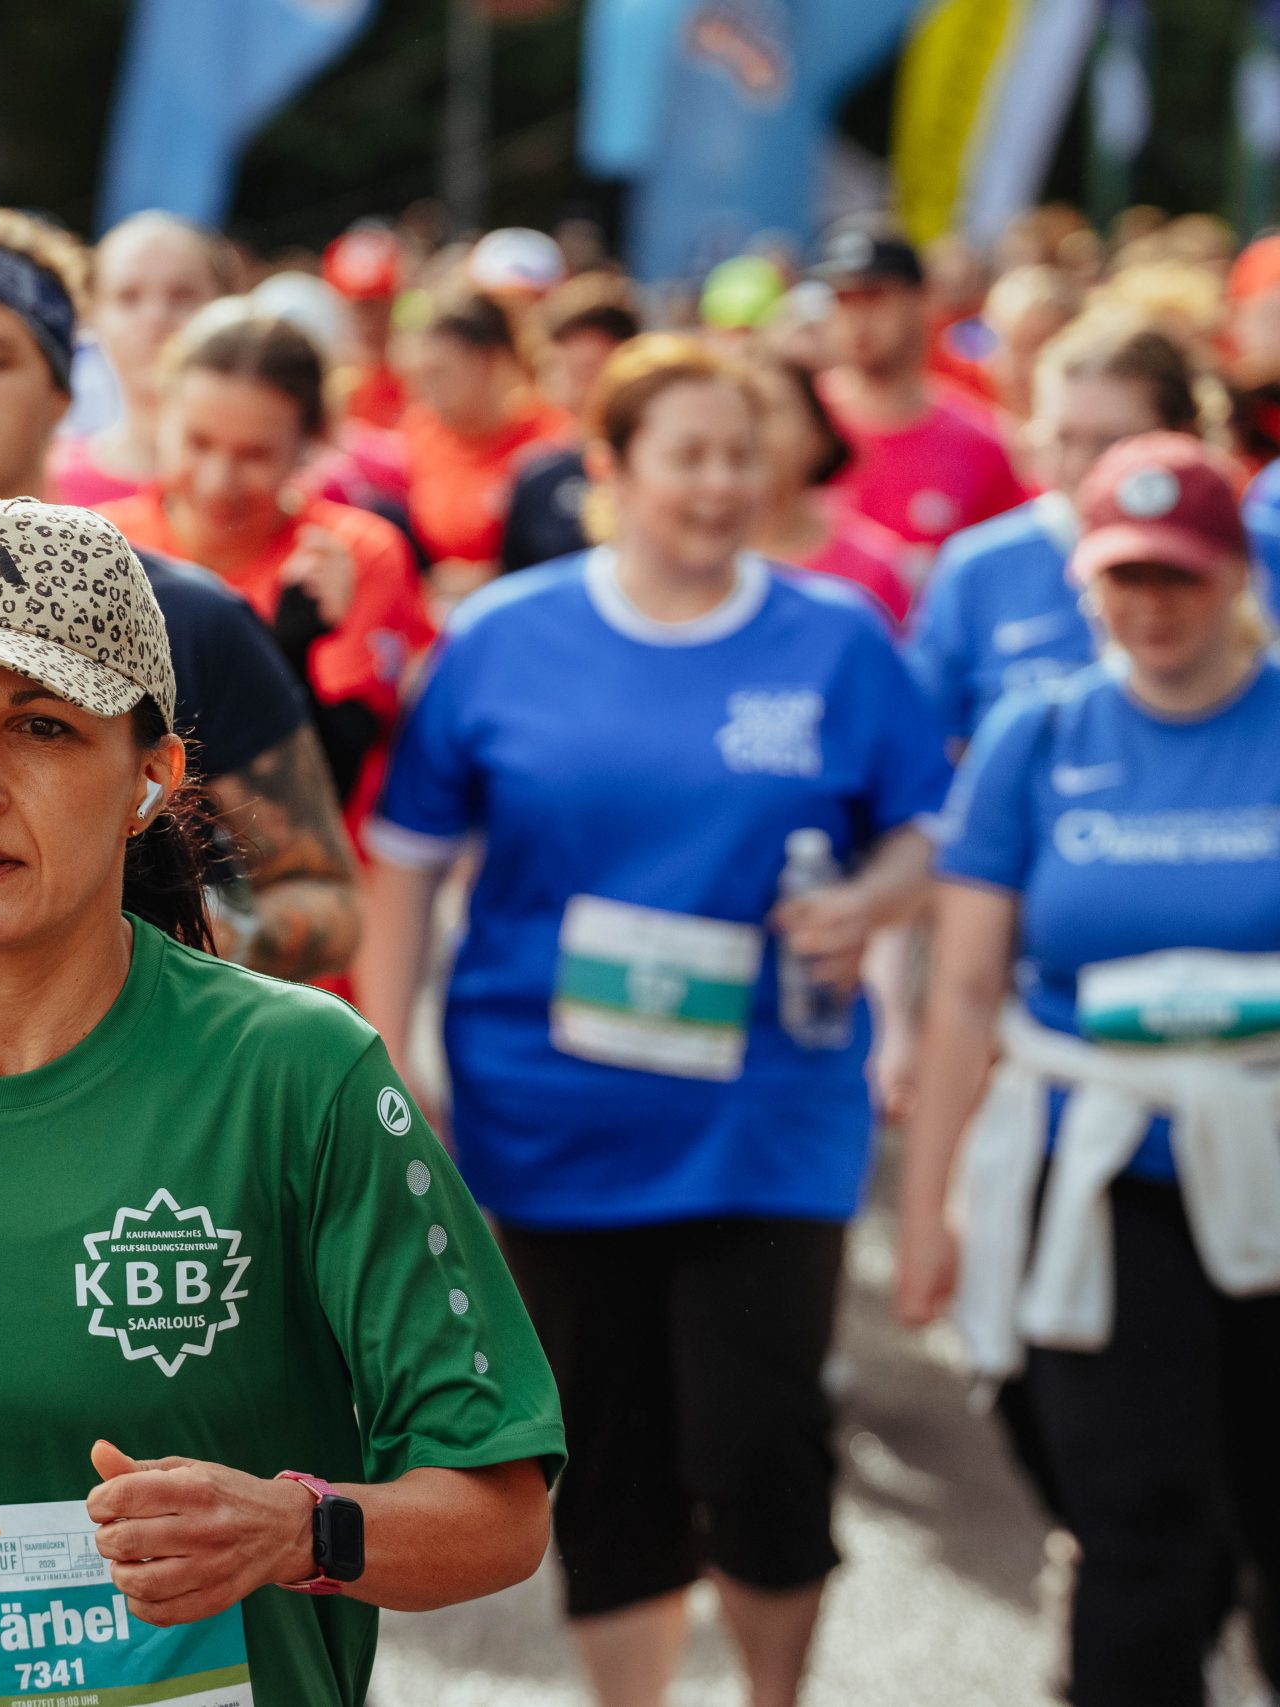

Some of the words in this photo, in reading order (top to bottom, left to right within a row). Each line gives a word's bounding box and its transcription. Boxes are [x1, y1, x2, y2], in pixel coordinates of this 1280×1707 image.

[111, 1243, 218, 1253] BERUFSBILDUNGSZENTRUM
[127, 1315, 206, 1331] SAARLOUIS
[24, 1539, 65, 1552] SAARBRÜCKEN
[14, 1657, 85, 1690] 7341
[56, 1695, 80, 1707] 18:00
[80, 1694, 99, 1706] UHR
